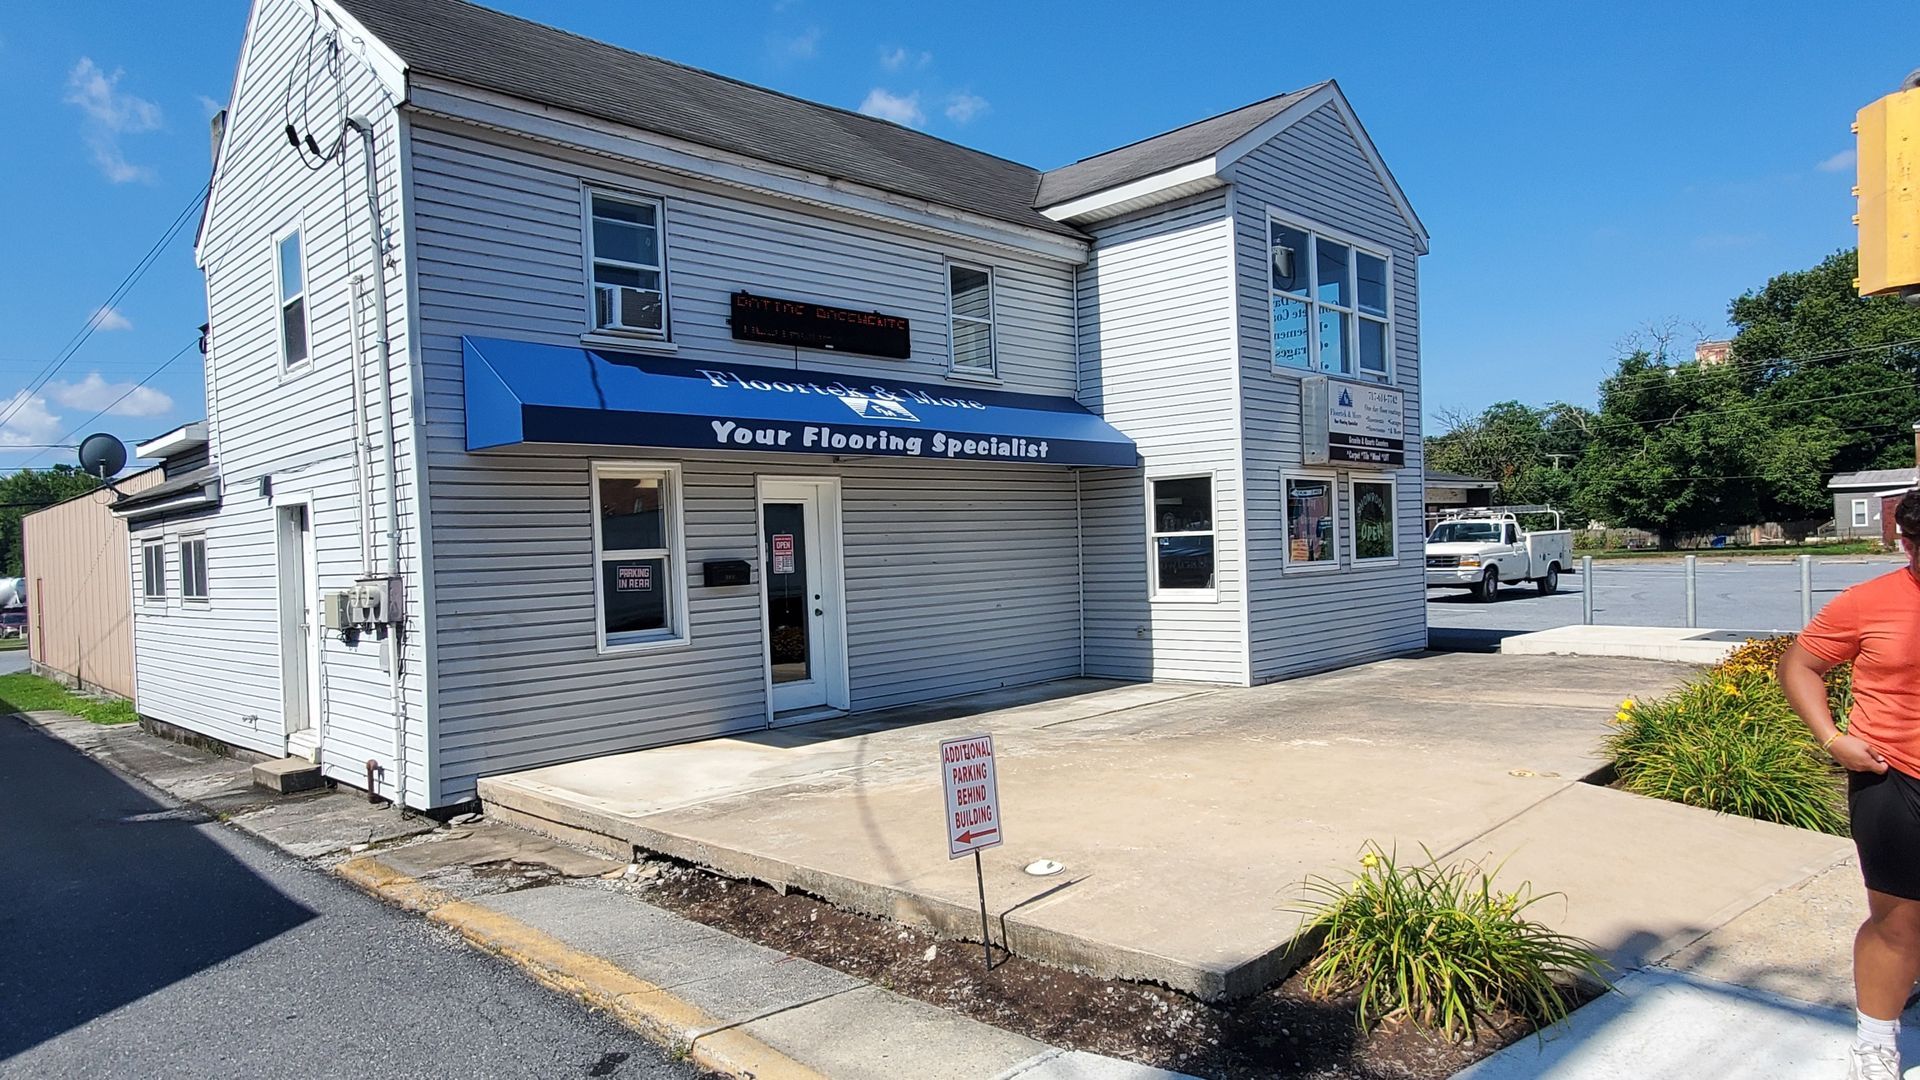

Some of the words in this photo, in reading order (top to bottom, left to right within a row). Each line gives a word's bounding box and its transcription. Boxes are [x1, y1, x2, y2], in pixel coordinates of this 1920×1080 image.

[696, 369, 869, 398] Floortek
[871, 385, 906, 402] &
[900, 388, 986, 410] More
[711, 420, 791, 446] Your
[802, 426, 923, 456] Flooring
[931, 432, 1049, 459] Specialist
[1361, 522, 1383, 541] OPEN
[776, 541, 790, 549] OPEN
[618, 579, 627, 588] IN
[629, 579, 649, 588] REAR
[619, 568, 649, 578] PARKING
[944, 740, 991, 764] ADDITIONAL
[952, 762, 987, 785] PARKING
[957, 784, 986, 806] BEHIND
[955, 804, 992, 829] BUILDING
